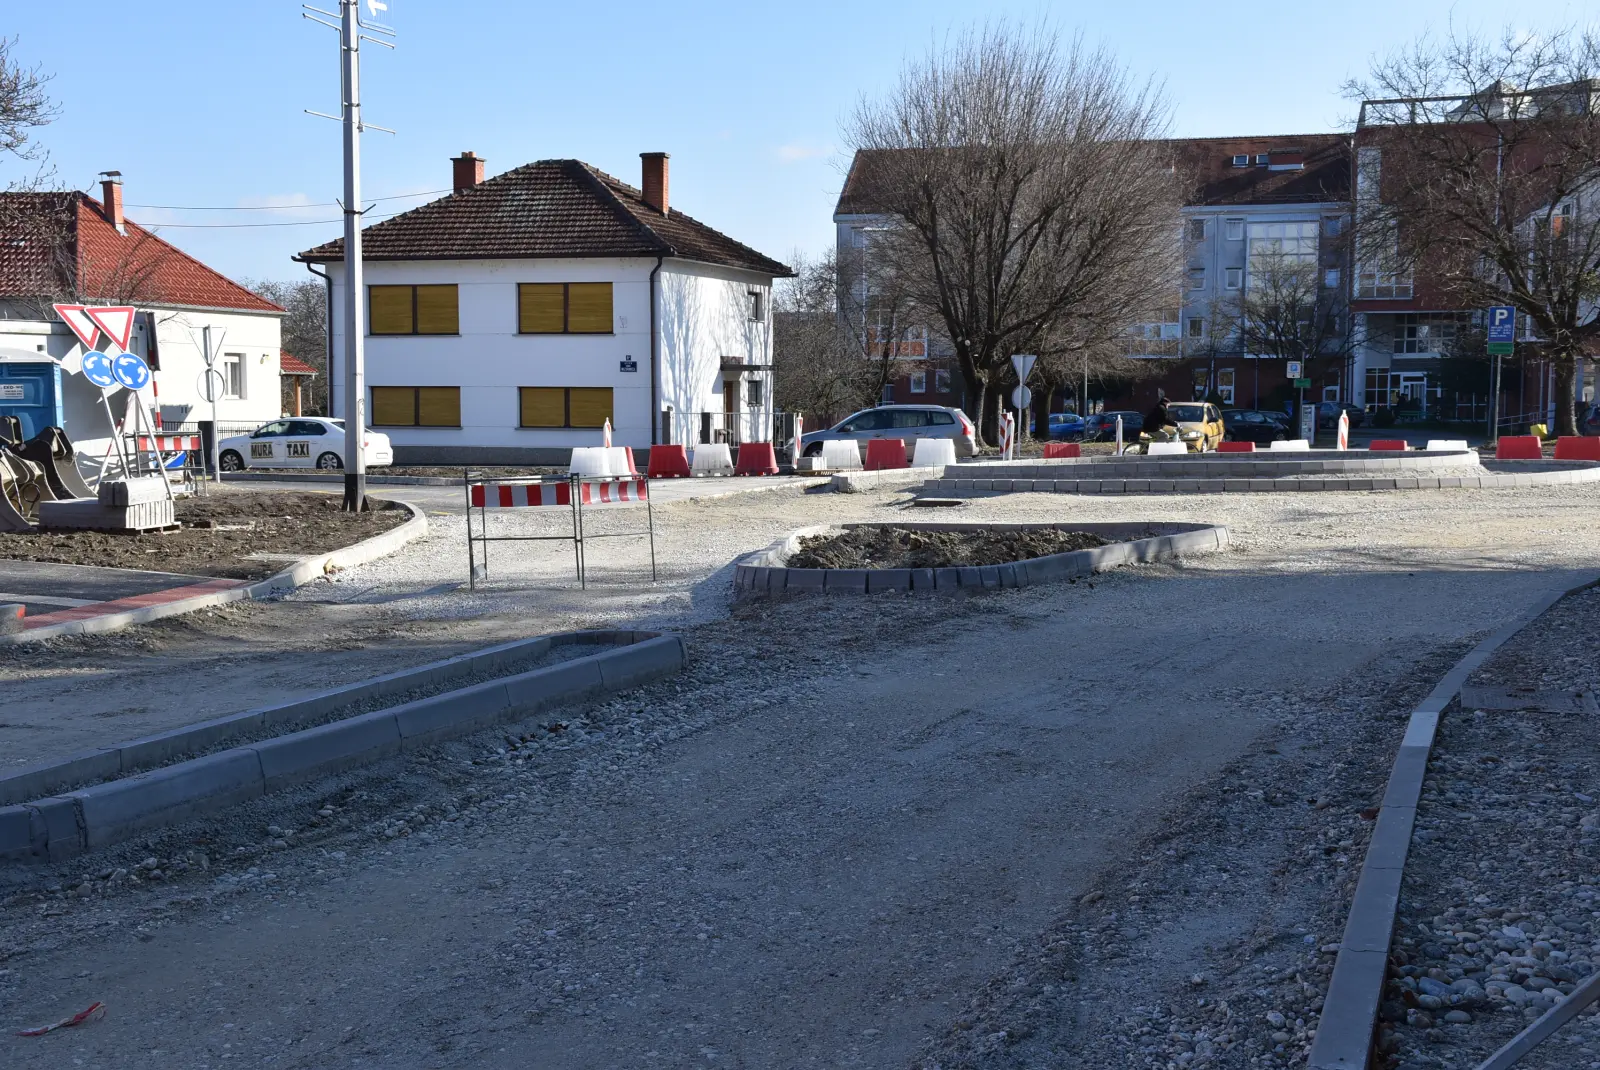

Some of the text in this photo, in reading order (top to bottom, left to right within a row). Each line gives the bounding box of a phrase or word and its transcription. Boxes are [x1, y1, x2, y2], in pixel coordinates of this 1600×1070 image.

[1495, 309, 1508, 325] P
[251, 443, 310, 456] MURA TAXI
